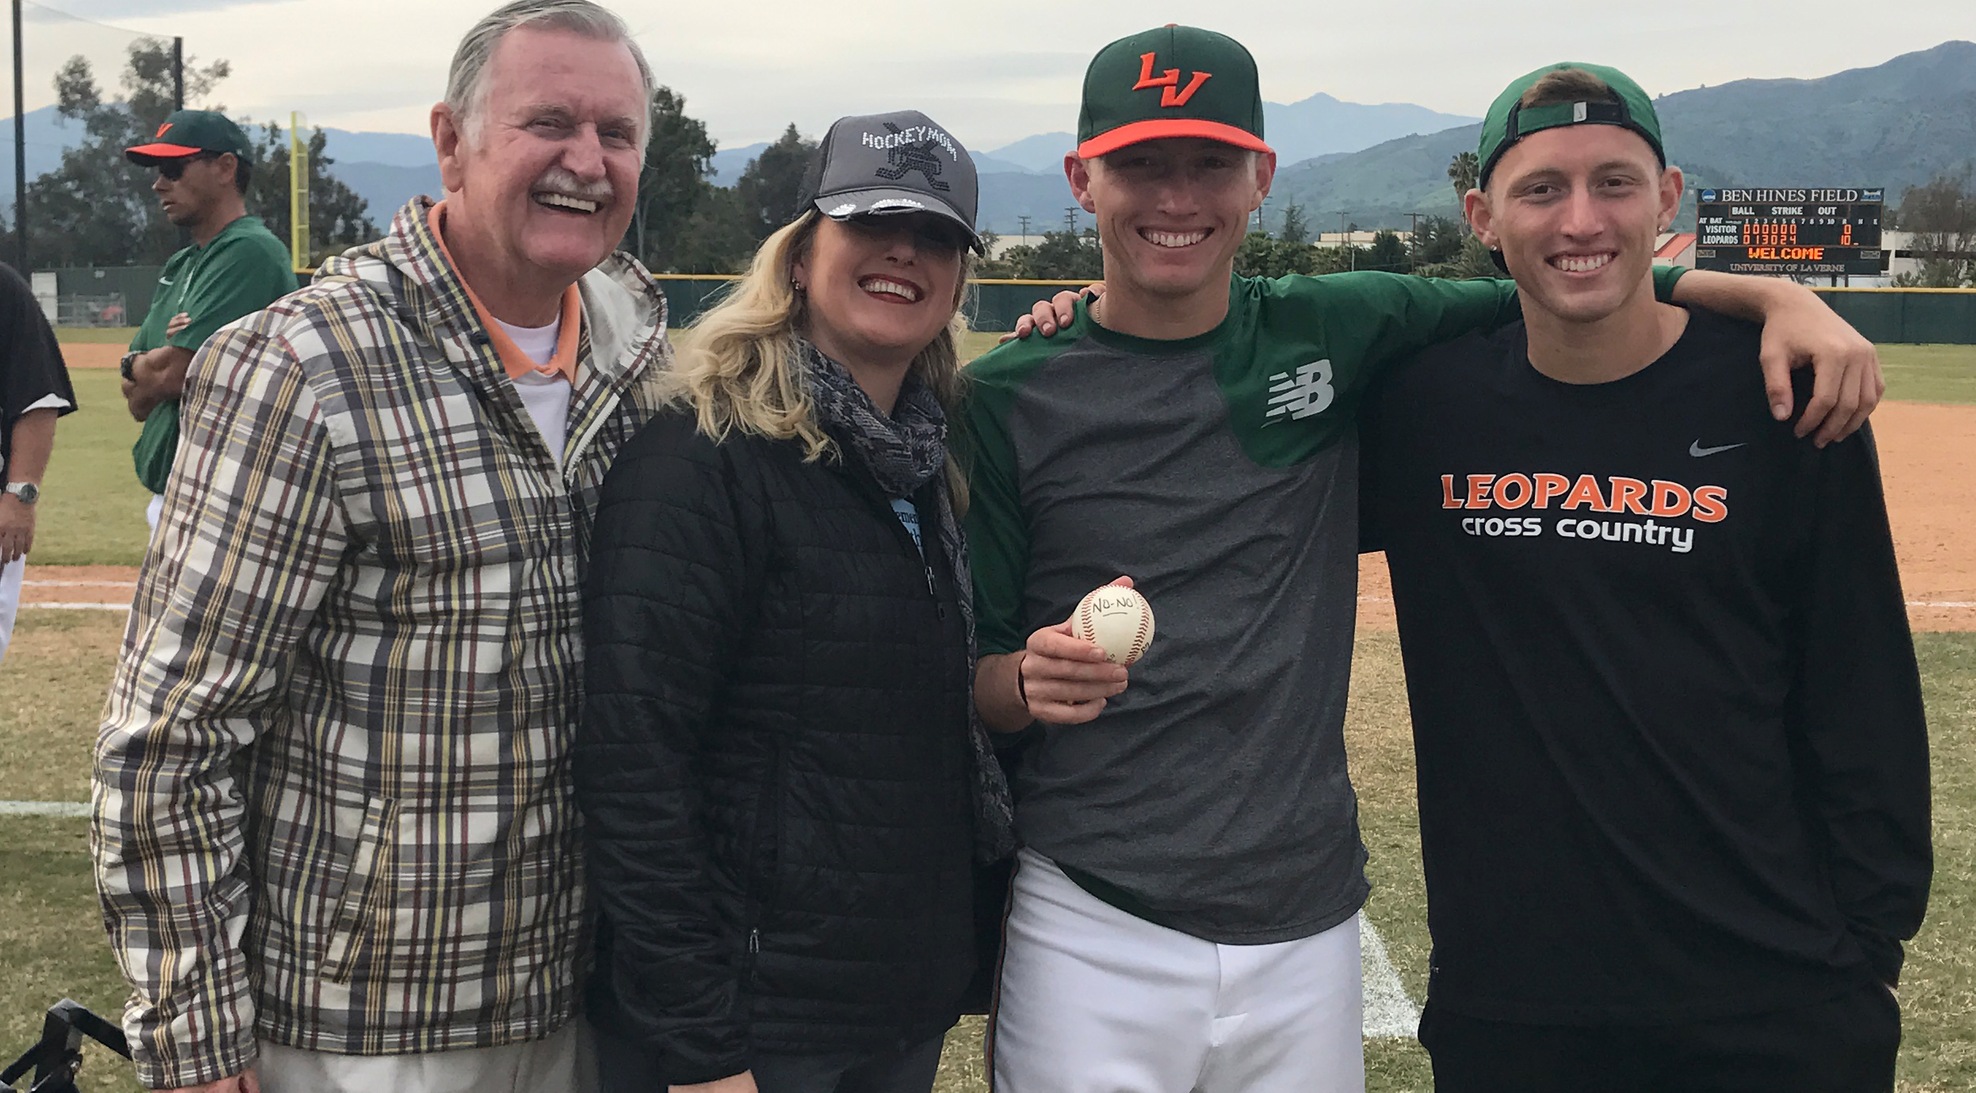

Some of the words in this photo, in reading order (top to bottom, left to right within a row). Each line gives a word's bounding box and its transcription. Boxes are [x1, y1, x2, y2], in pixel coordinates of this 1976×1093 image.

[1131, 51, 1212, 108] LV
[862, 125, 927, 149] HOCKEY
[926, 127, 957, 161] MOM
[1722, 189, 1753, 202] BEN
[1756, 189, 1806, 202] HINES
[1810, 189, 1858, 202] FIELD
[1731, 206, 1755, 215] BALL
[1771, 206, 1803, 215] STRIKE
[1817, 206, 1837, 215] OUT
[1705, 225, 1737, 234] VISITOR
[1702, 235, 1738, 244] LEOPARDS
[1748, 247, 1825, 260] WELCOME
[1730, 263, 1786, 272] UNIVERSITY
[1785, 264, 1798, 272] OF
[1800, 264, 1814, 272] LA
[1813, 264, 1845, 272] VERNE
[1440, 472, 1729, 523] LEOPARDS
[1461, 517, 1543, 537] cross
[1556, 518, 1694, 553] country
